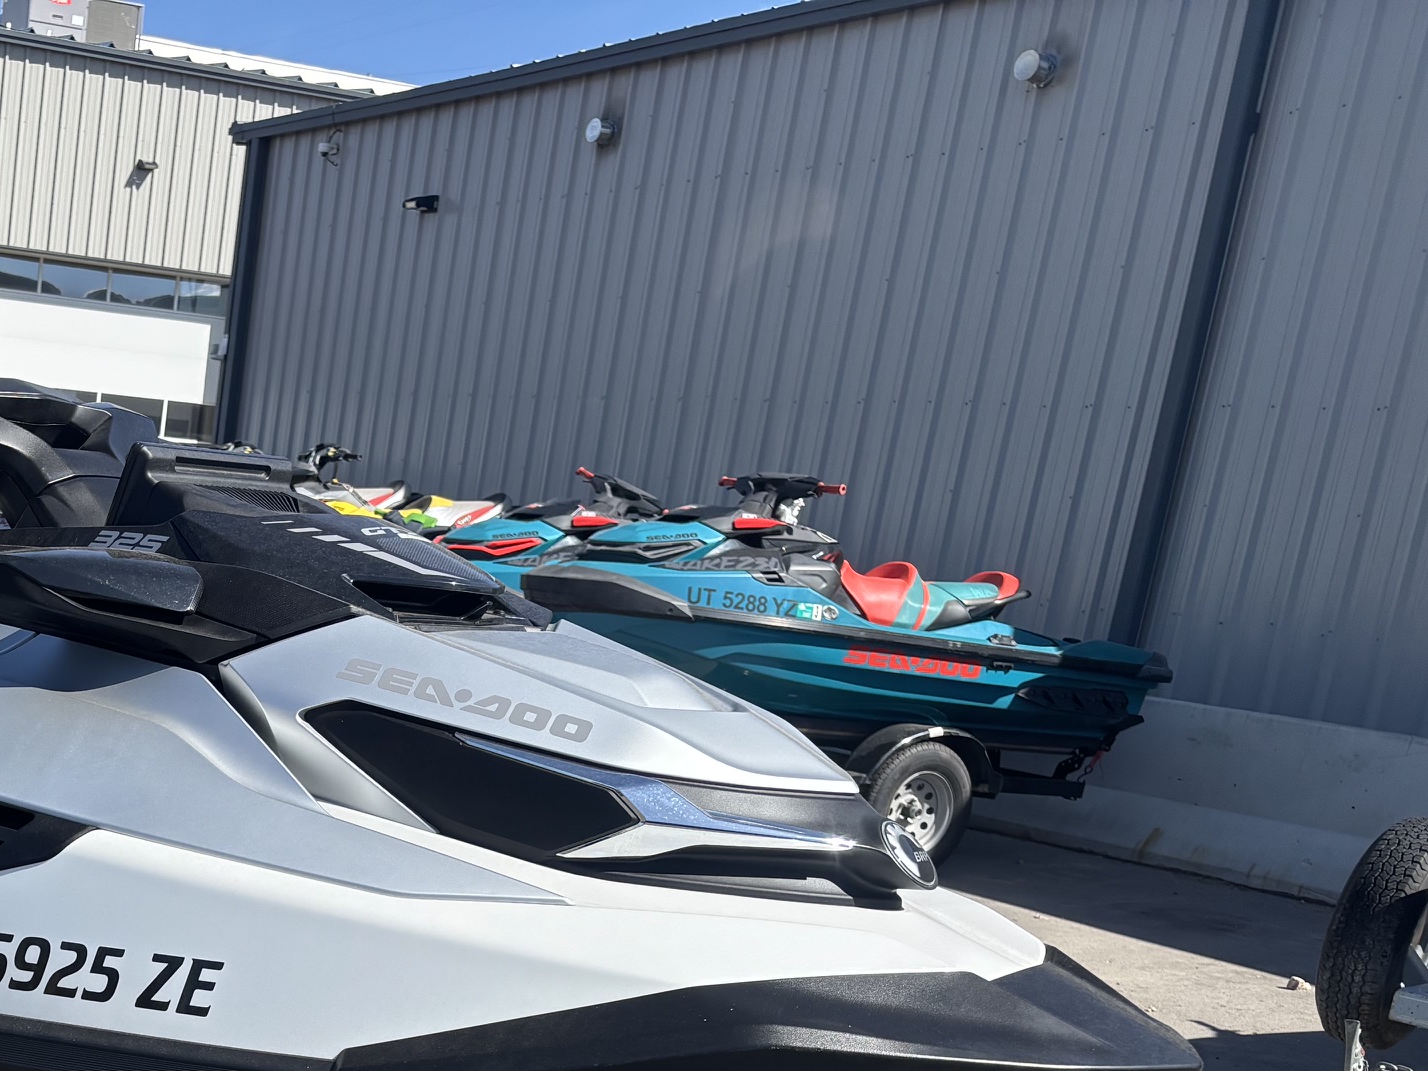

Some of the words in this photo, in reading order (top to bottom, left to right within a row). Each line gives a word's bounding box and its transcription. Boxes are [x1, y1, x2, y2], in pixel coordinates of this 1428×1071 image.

[90, 530, 171, 554] 325
[687, 587, 717, 606] UT
[722, 591, 768, 613] 5288
[772, 597, 798, 617] YZ
[134, 953, 225, 1017] ZE
